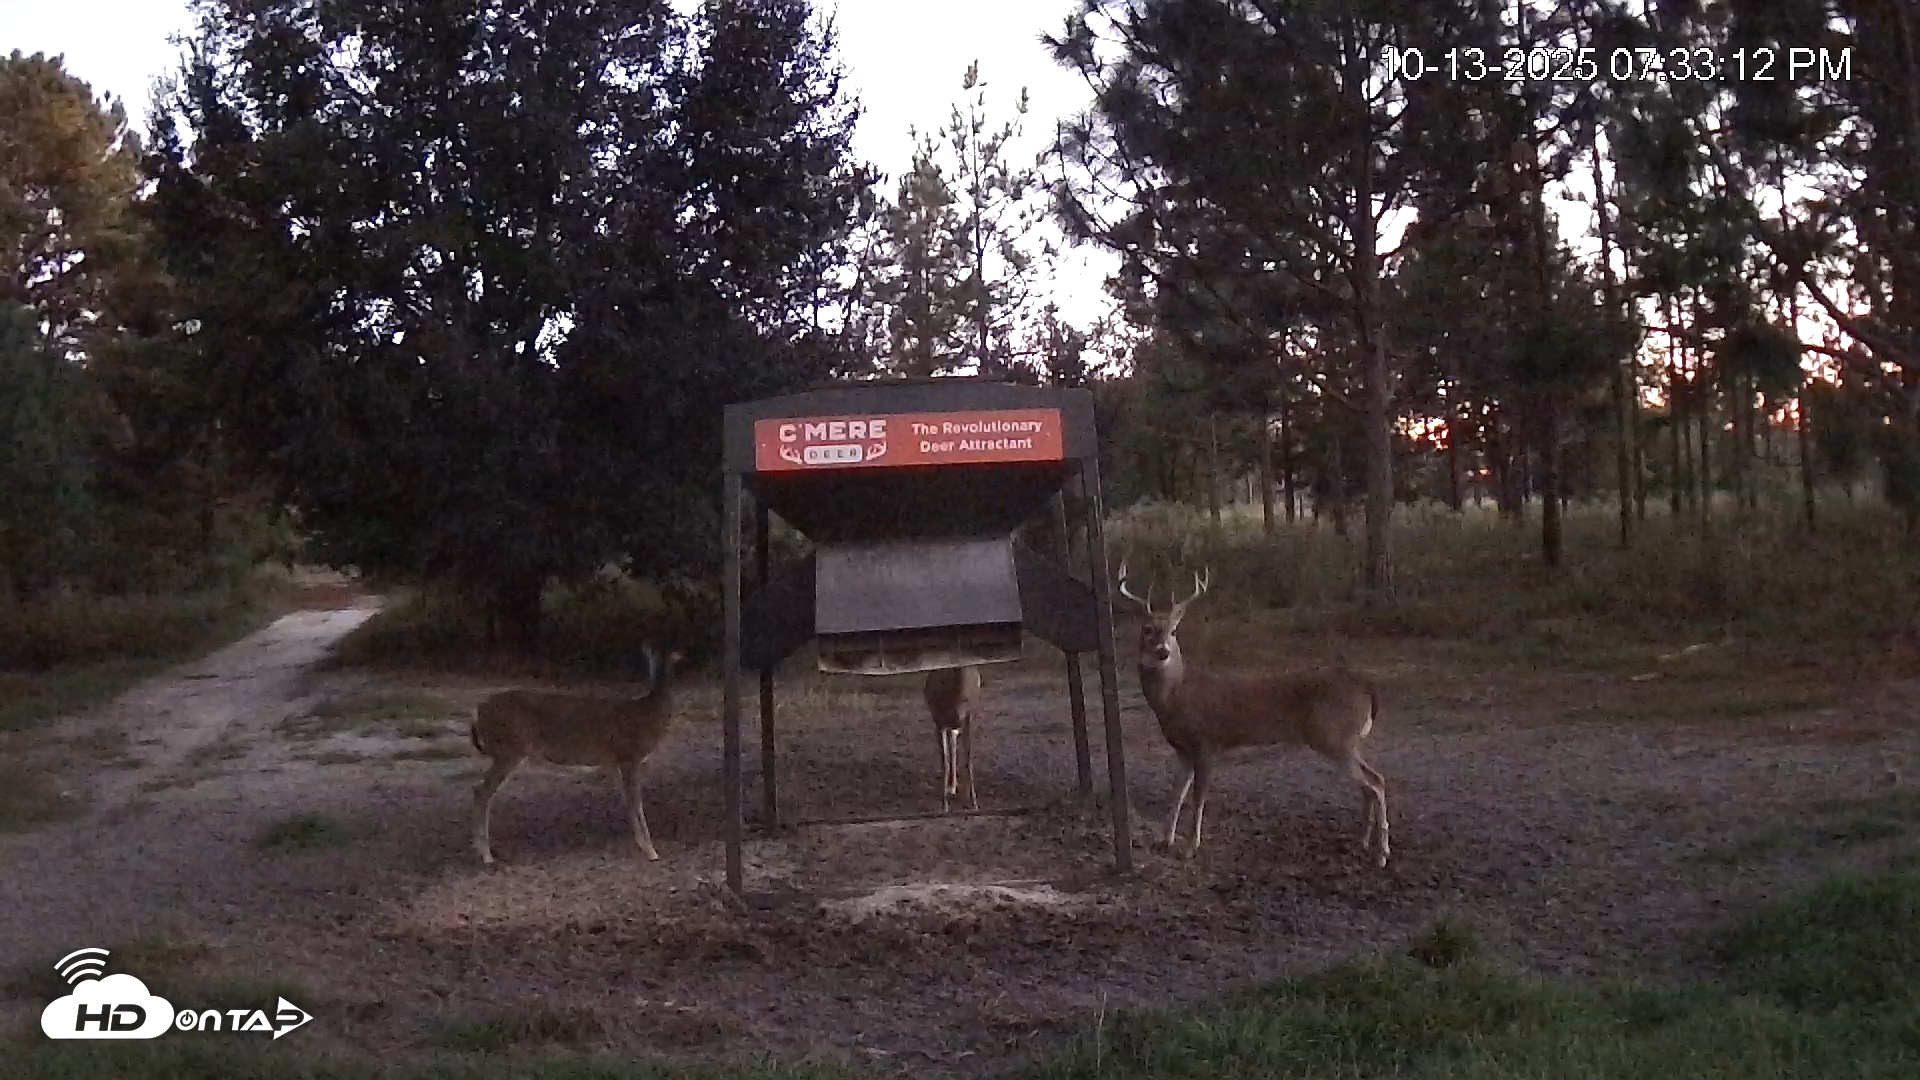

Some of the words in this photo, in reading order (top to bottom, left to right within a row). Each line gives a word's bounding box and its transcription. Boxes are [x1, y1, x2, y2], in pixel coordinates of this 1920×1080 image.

[779, 420, 887, 442] C'MERE
[911, 423, 938, 435] The
[942, 420, 1043, 434] Revolutionary
[919, 440, 954, 452] Deer
[959, 437, 1033, 450] Attractant
